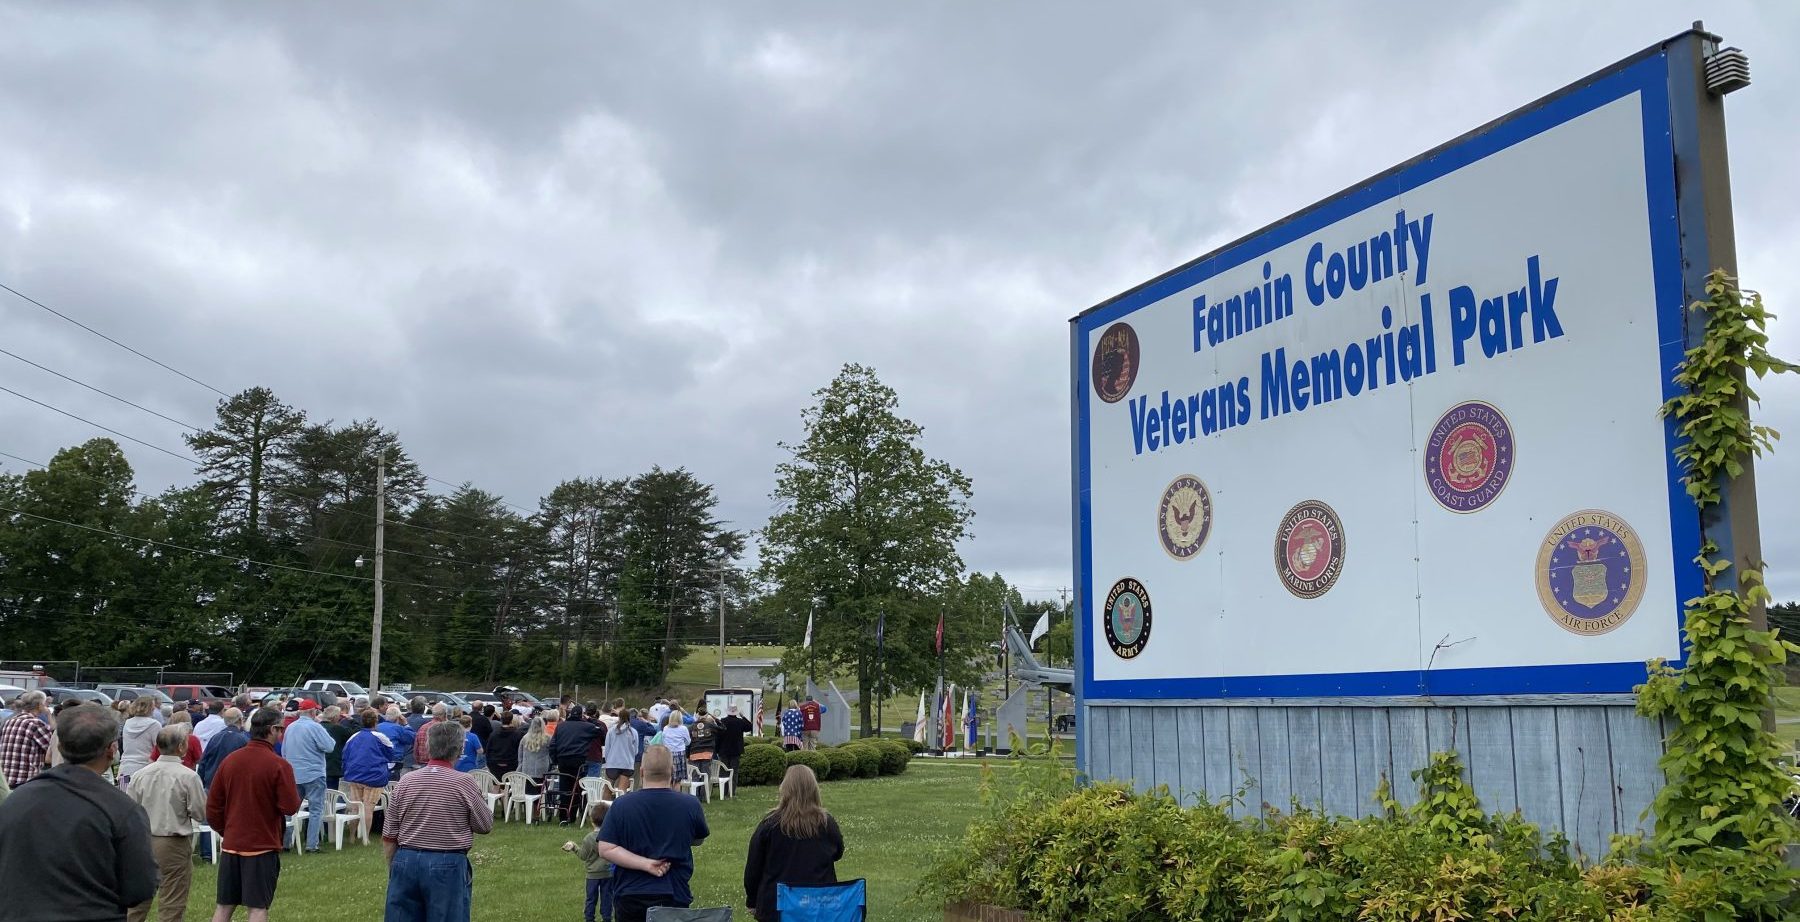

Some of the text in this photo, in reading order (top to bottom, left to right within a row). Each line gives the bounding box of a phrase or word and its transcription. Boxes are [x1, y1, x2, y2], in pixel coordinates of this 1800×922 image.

[1193, 209, 1433, 353] Fannin County
[1129, 255, 1564, 455] Veterans Memorial Park
[1431, 407, 1506, 447] UNITED STATES
[1433, 470, 1504, 507] COAST GUARD
[1282, 509, 1338, 542] UNITED STATES
[1548, 515, 1628, 546] UNITED STATES
[1172, 543, 1199, 556] NAVY
[1284, 556, 1338, 591] MARINE CORPS
[1106, 581, 1149, 611] UNITED STATES
[1561, 612, 1623, 631] AIR FORCE
[1116, 644, 1139, 657] ARMY
